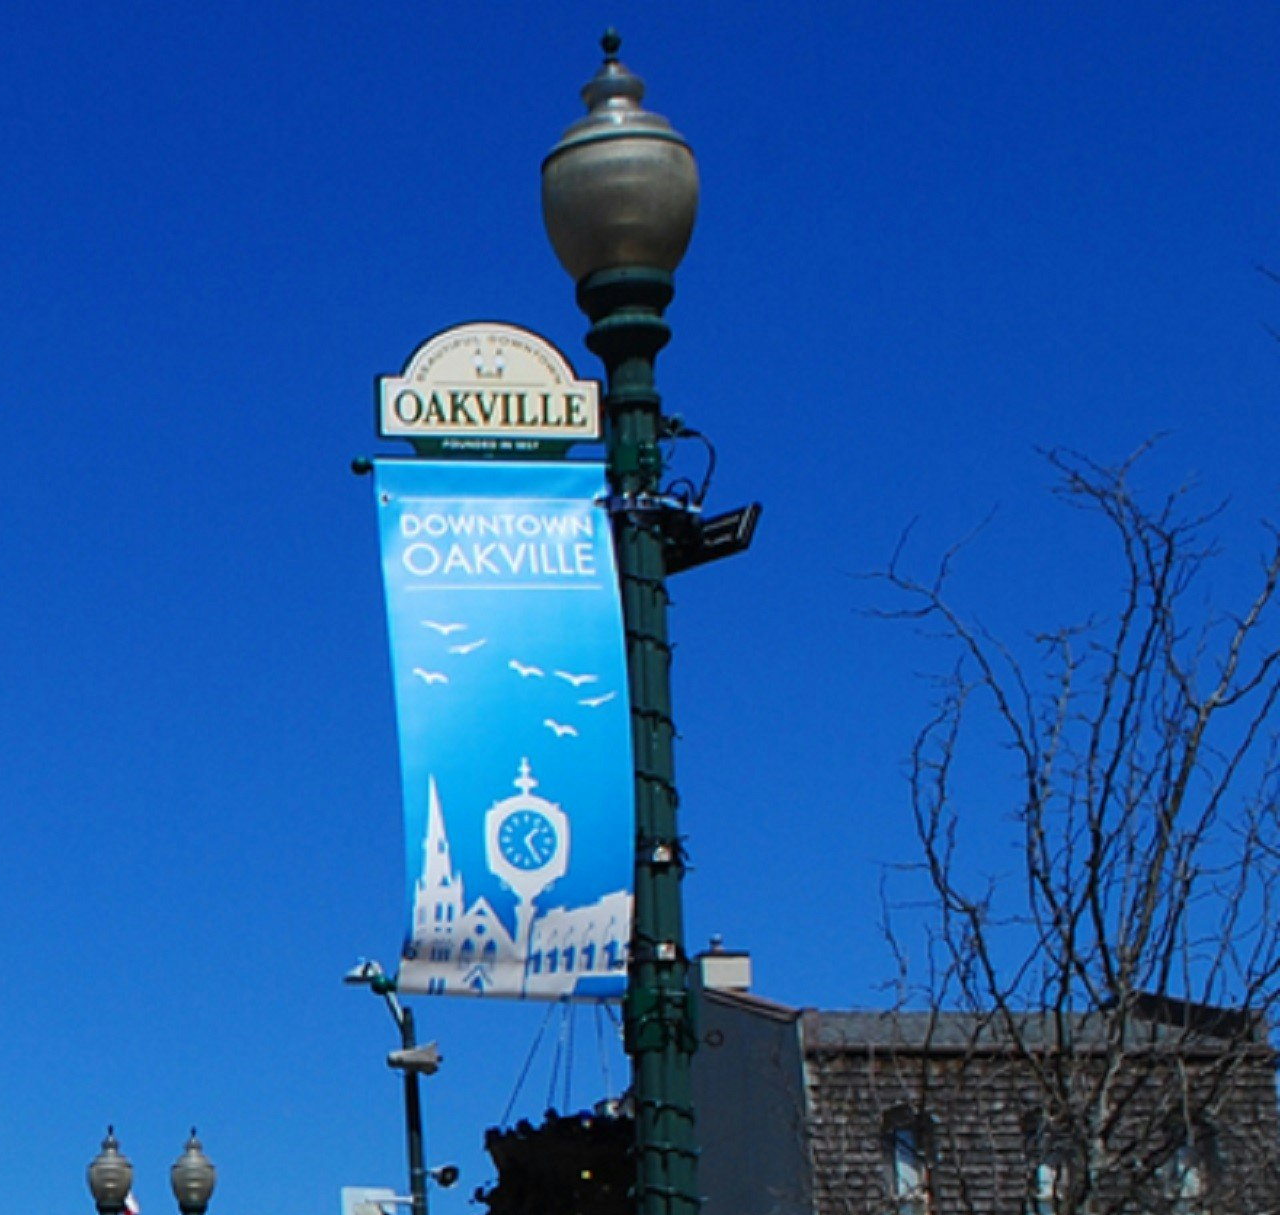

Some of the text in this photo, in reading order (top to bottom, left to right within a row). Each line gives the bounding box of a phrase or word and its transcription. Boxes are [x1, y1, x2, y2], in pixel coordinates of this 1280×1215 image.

[394, 389, 589, 428] OAKVILLE
[400, 513, 593, 538] DOWNTOWN
[402, 543, 596, 577] OAKVILLE
